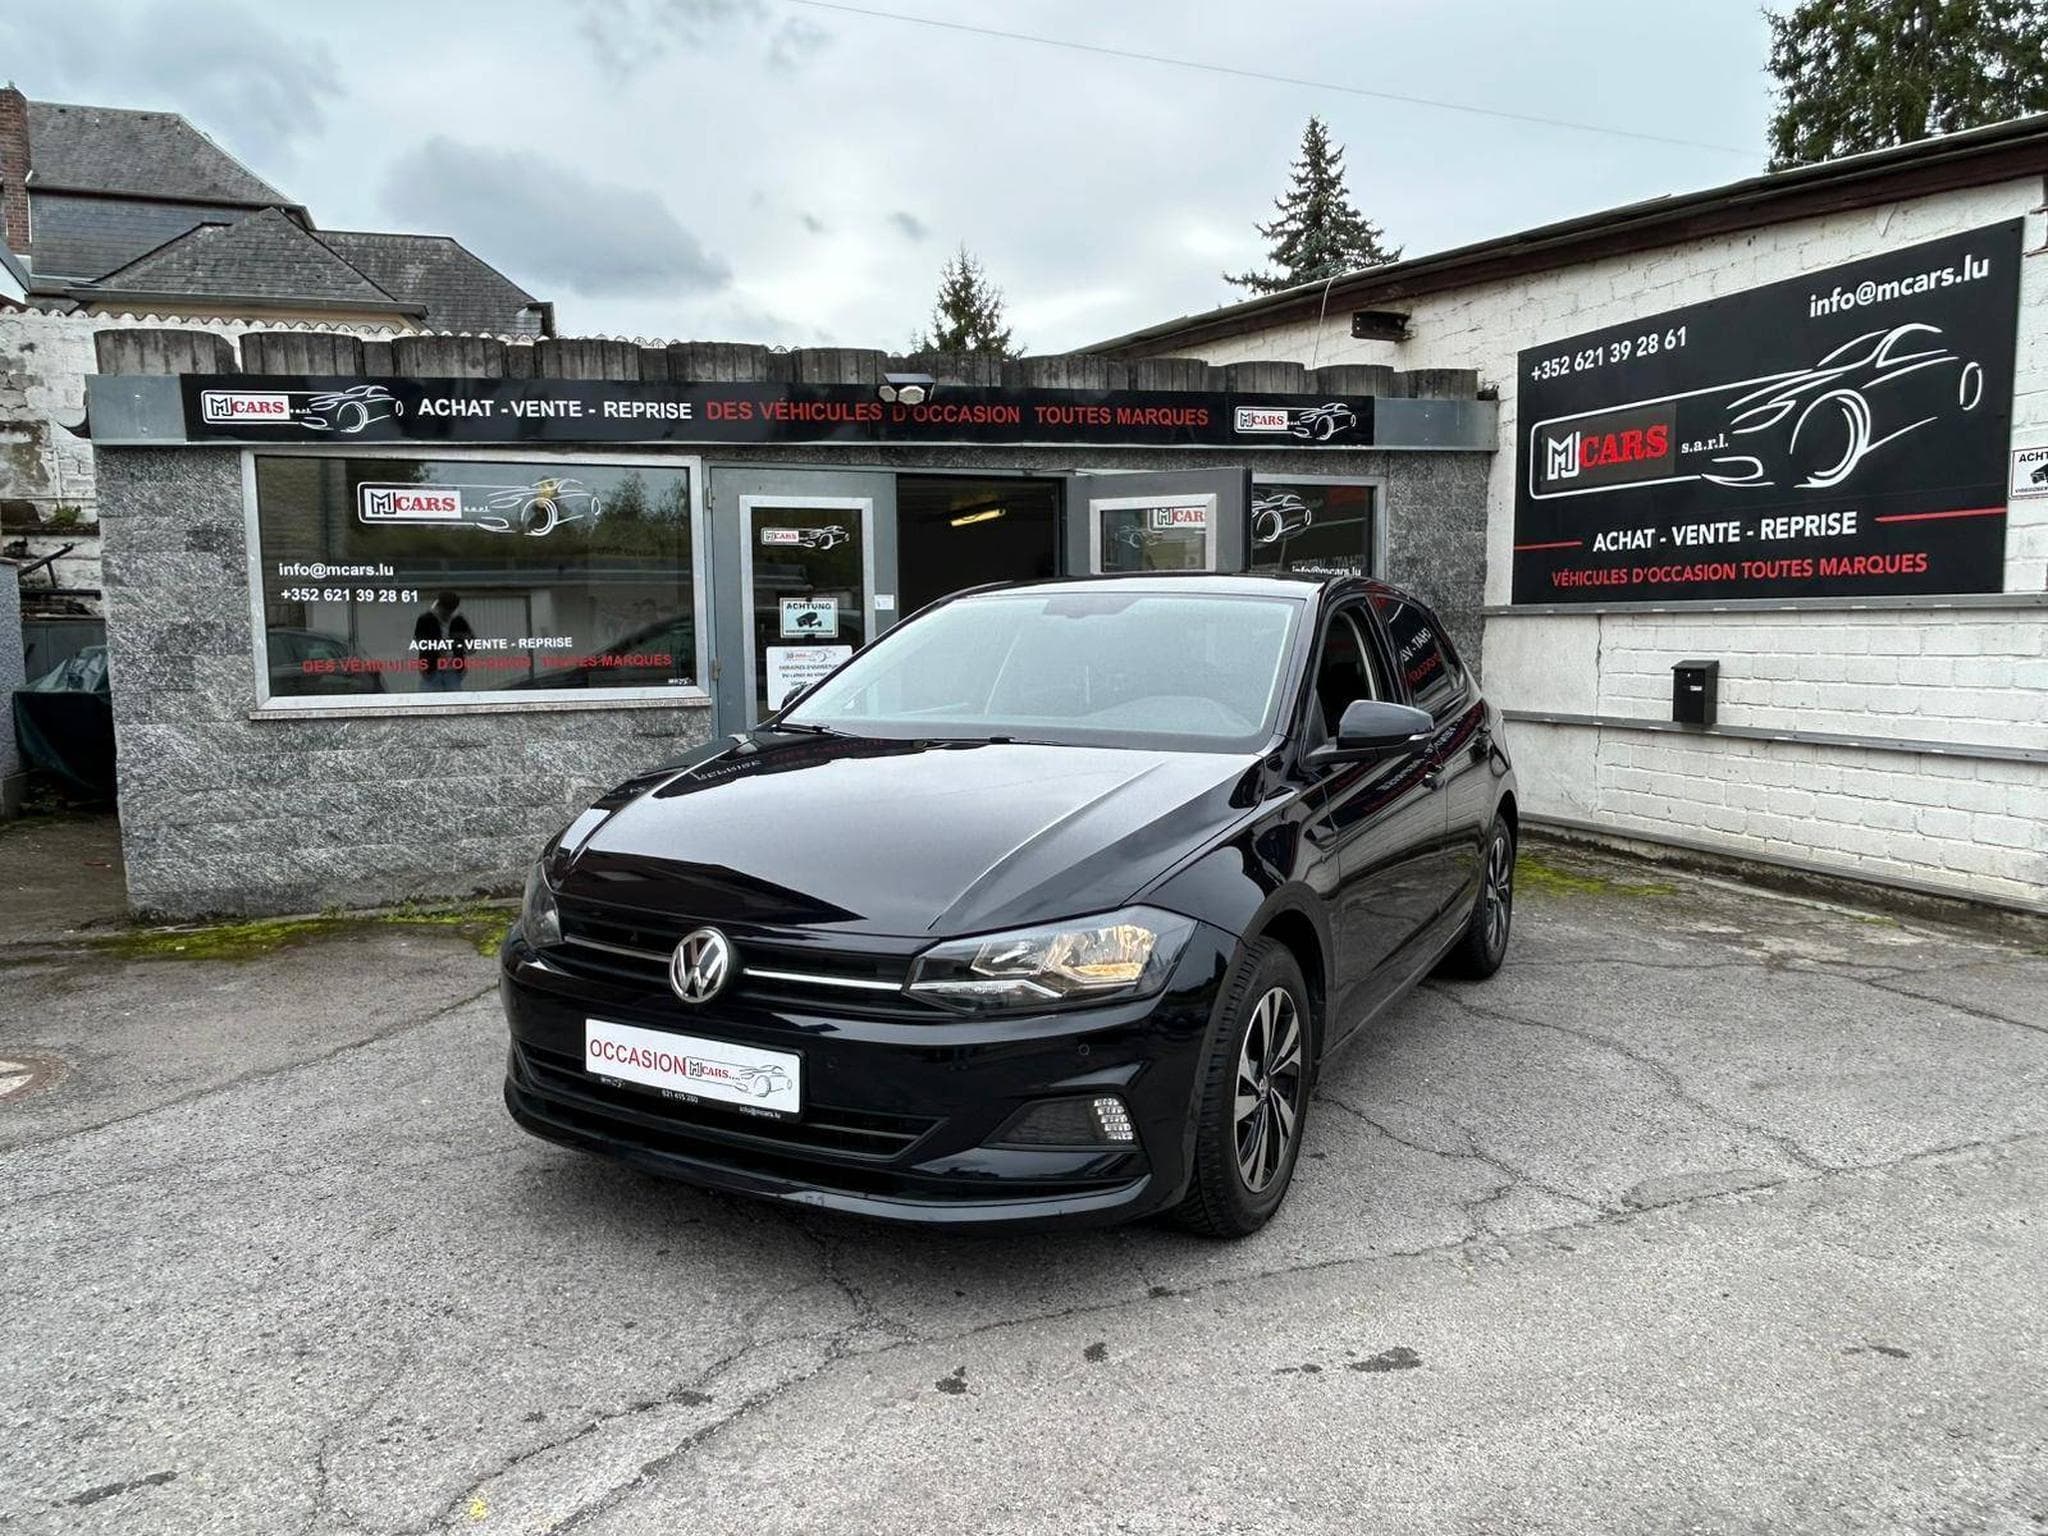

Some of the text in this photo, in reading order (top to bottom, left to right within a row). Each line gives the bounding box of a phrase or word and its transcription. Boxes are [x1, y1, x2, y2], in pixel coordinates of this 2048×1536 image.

[1809, 254, 1989, 317] info@mcars.lu
[1531, 326, 1687, 380] +352 621 39 28 61
[418, 398, 494, 417] ACHAT
[603, 401, 693, 419] REPRISE
[707, 401, 752, 420] DES
[759, 398, 883, 421] VÉHICULES
[1034, 406, 1112, 425] TOUTES
[1117, 408, 1209, 426] MARQUES
[1681, 433, 1729, 454] s.a.r.l.
[1593, 528, 1656, 552] ACHAT
[1672, 521, 1740, 546] VENTE
[1761, 511, 1857, 540] REPRISE
[279, 563, 394, 579] info@mcars.lu
[1552, 553, 1927, 587] VÉHICULES D'OCCASION TOUTES MARQUES
[281, 588, 418, 603] +352 621 39 28 61
[786, 602, 831, 610] ACHTUNG
[409, 639, 454, 650] ACHAT
[464, 638, 508, 650] VENTE
[518, 637, 573, 648] REPRISE
[303, 659, 332, 673] DES
[602, 655, 673, 667] MARQUES
[590, 1039, 687, 1076] OCCASION
